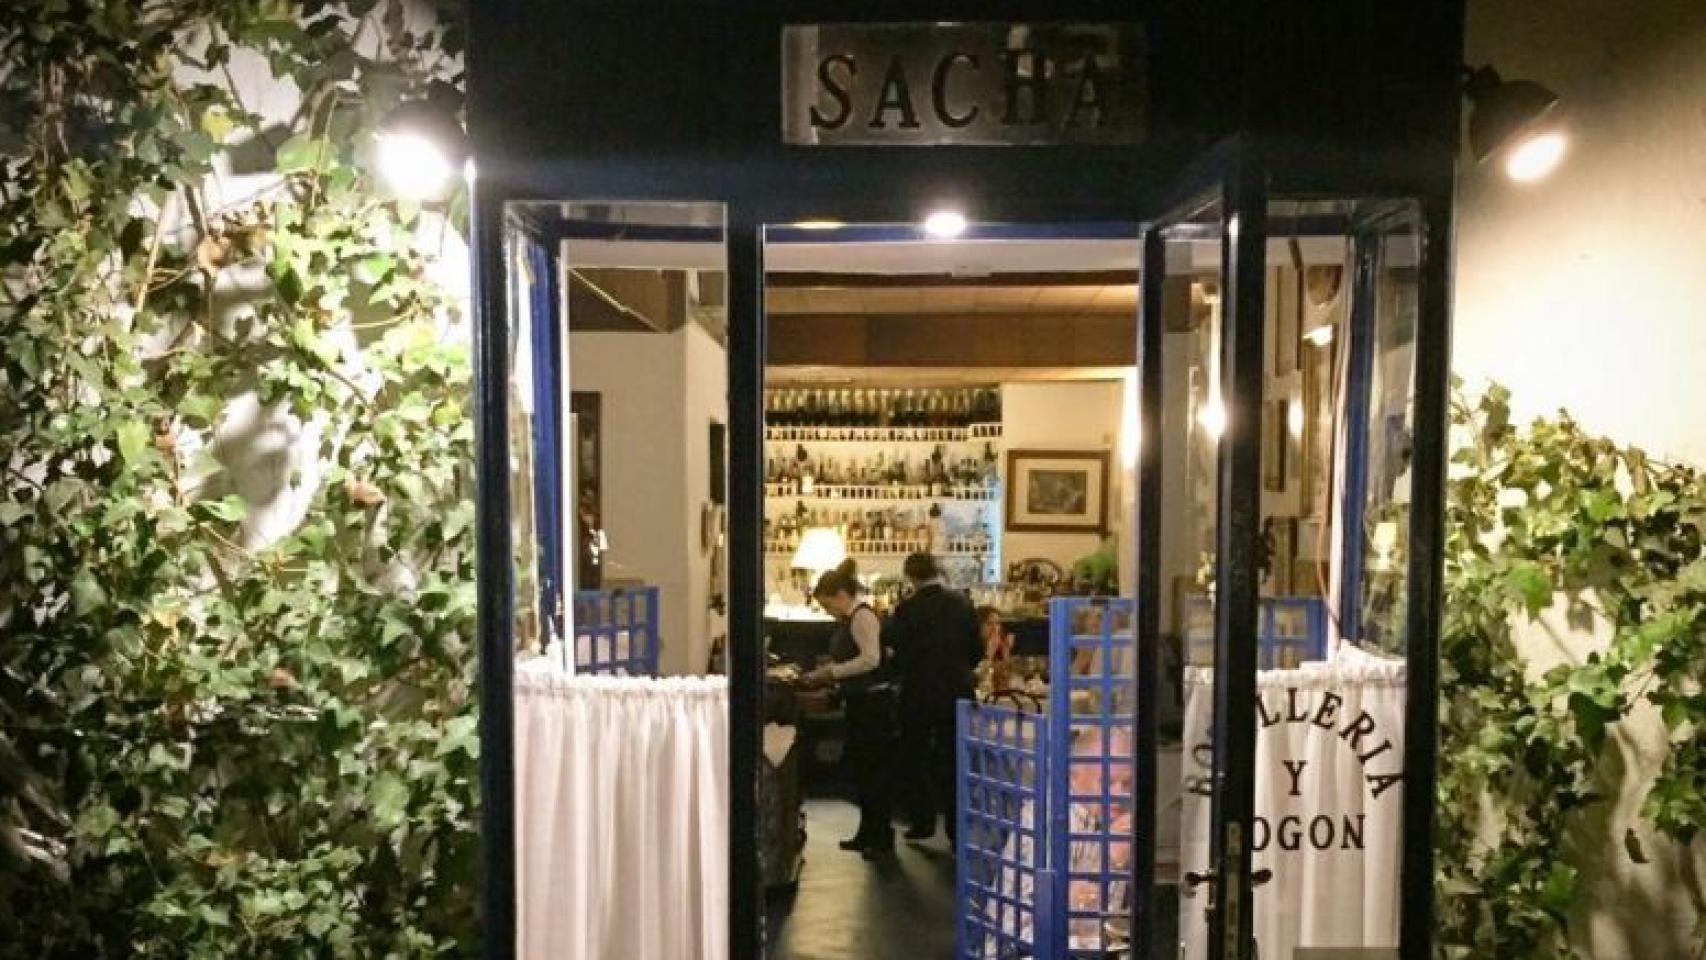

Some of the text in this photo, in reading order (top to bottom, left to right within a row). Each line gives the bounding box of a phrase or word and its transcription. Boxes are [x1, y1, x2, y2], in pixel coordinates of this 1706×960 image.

[810, 53, 1106, 130] SACHA
[1282, 760, 1306, 796] Y
[1252, 814, 1365, 851] OGON
